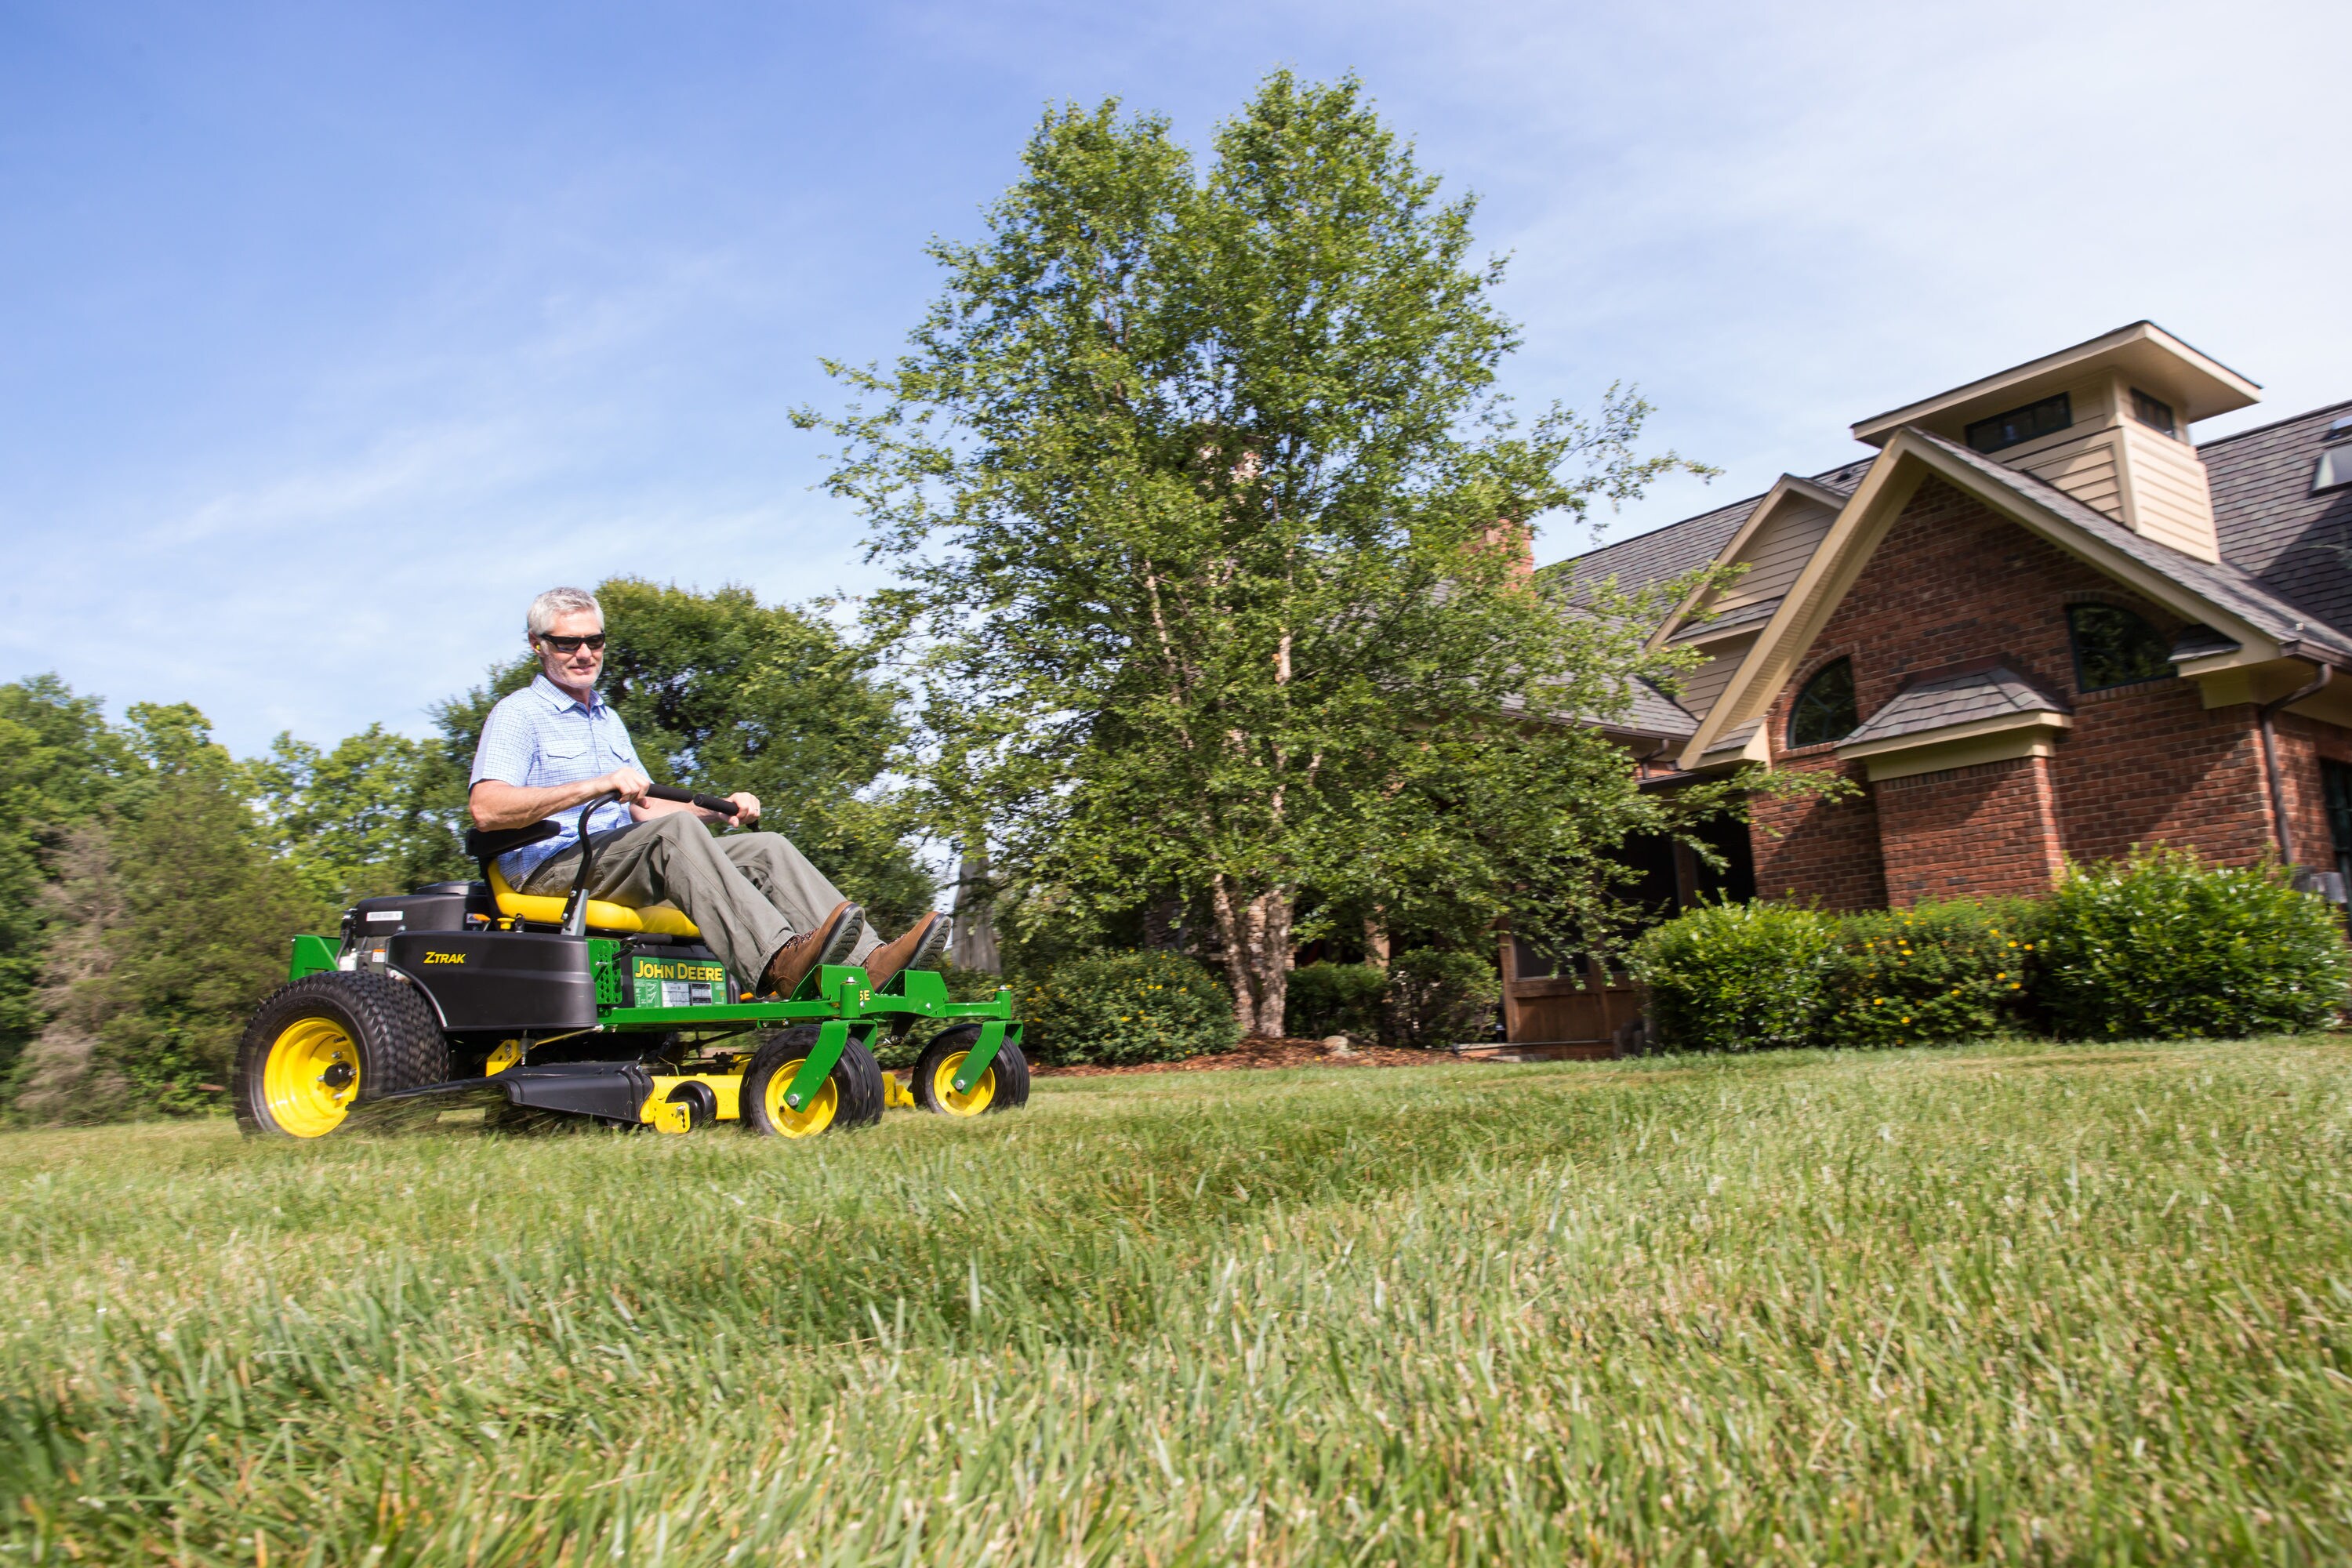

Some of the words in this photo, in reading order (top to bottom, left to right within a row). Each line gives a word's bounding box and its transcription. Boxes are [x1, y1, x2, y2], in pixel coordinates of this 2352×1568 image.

[423, 951, 466, 964] ZTRAK
[635, 960, 674, 978] JOHN
[677, 962, 724, 982] DEERE
